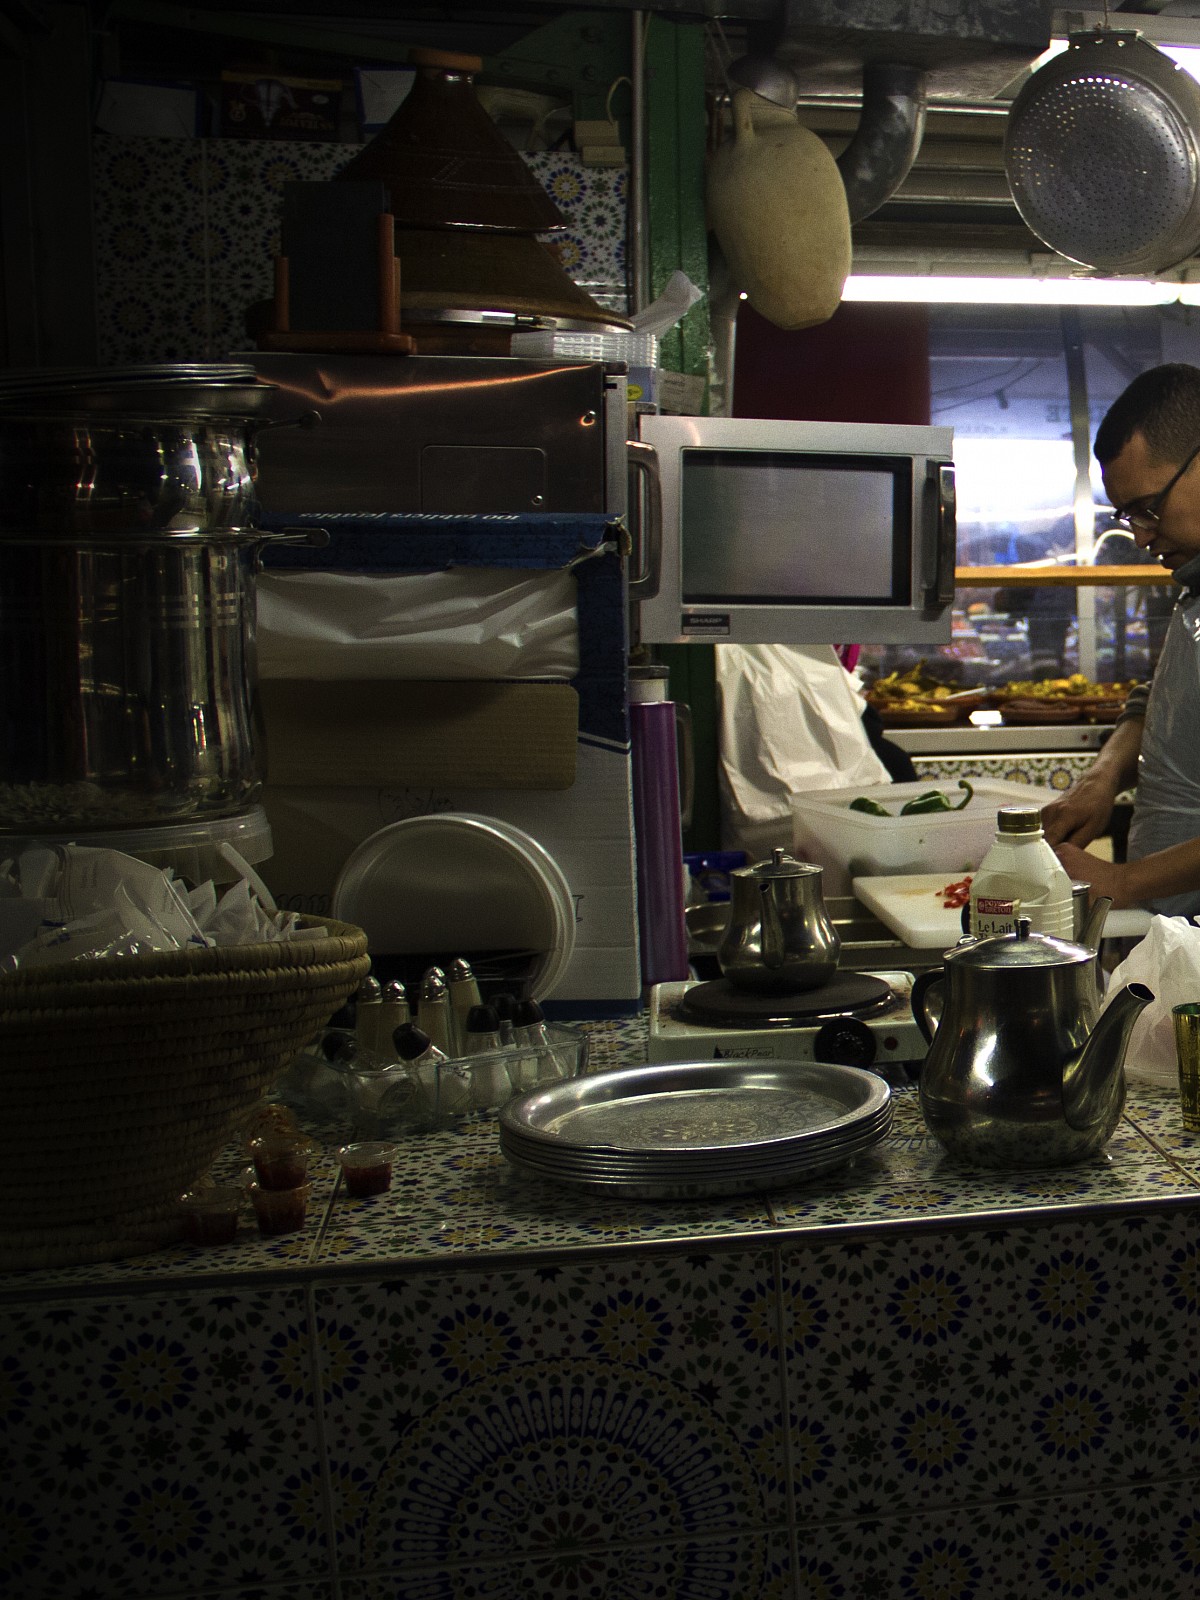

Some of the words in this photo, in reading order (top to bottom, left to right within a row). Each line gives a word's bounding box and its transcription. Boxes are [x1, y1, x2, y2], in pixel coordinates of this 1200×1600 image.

[298, 510, 387, 520] jetables
[391, 512, 477, 521] tabliers
[483, 513, 520, 521] 100
[978, 920, 990, 933] Le
[992, 921, 1012, 934] Lait
